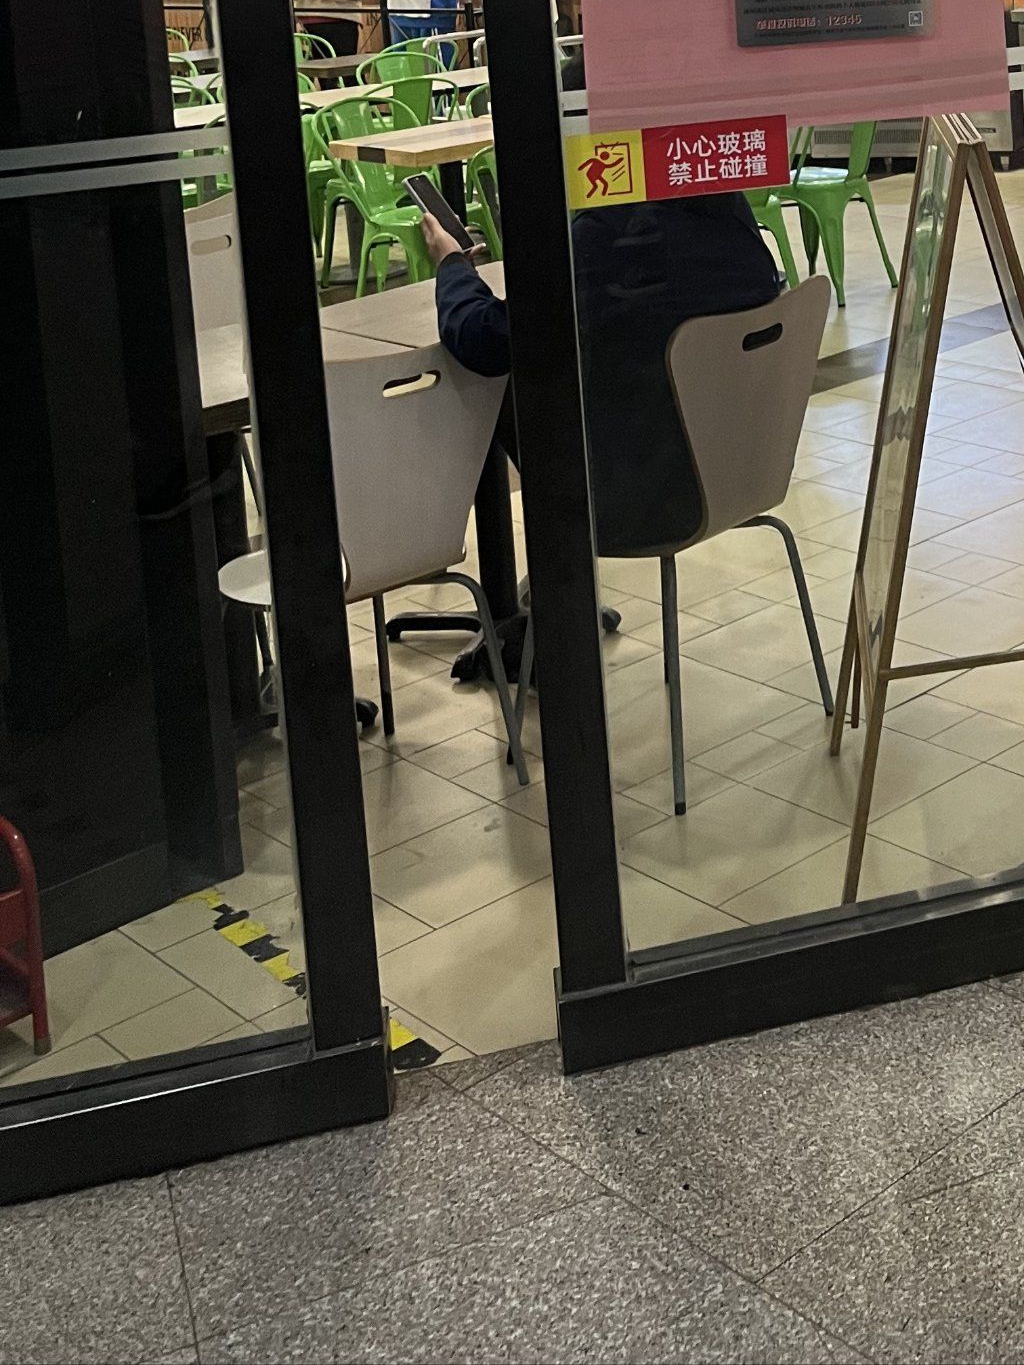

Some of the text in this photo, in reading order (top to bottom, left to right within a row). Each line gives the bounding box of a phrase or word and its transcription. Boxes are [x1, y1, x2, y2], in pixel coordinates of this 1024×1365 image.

[666, 128, 766, 161] 小心玻璃
[668, 153, 769, 186] 禁止碰撞
